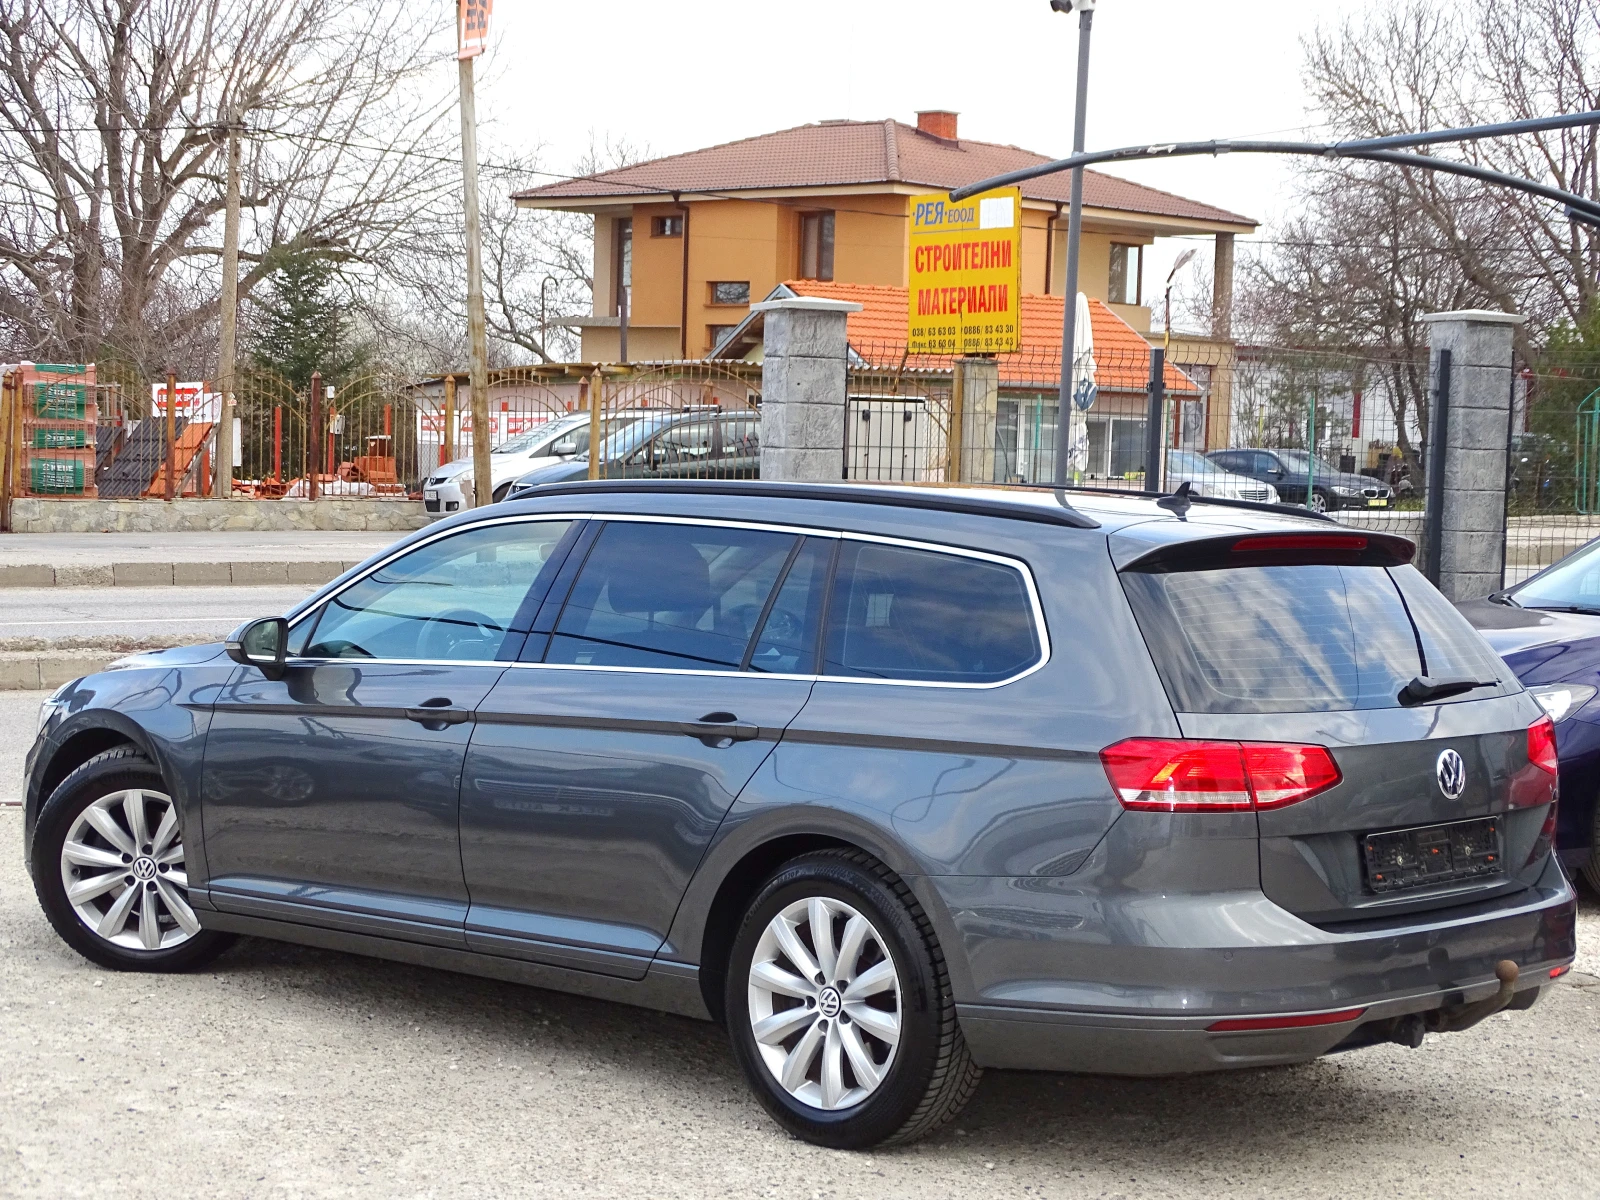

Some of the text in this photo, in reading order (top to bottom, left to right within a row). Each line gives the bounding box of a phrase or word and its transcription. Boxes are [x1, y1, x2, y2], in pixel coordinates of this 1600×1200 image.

[948, 207, 974, 224] ЕООД
[915, 240, 1012, 274] СТРОИТЕЛНИ
[918, 284, 1008, 316] МАТЕРИАЛИ
[948, 326, 955, 335] 03
[985, 325, 992, 334] 83
[995, 325, 1003, 333] 43
[1006, 324, 1013, 333] 30
